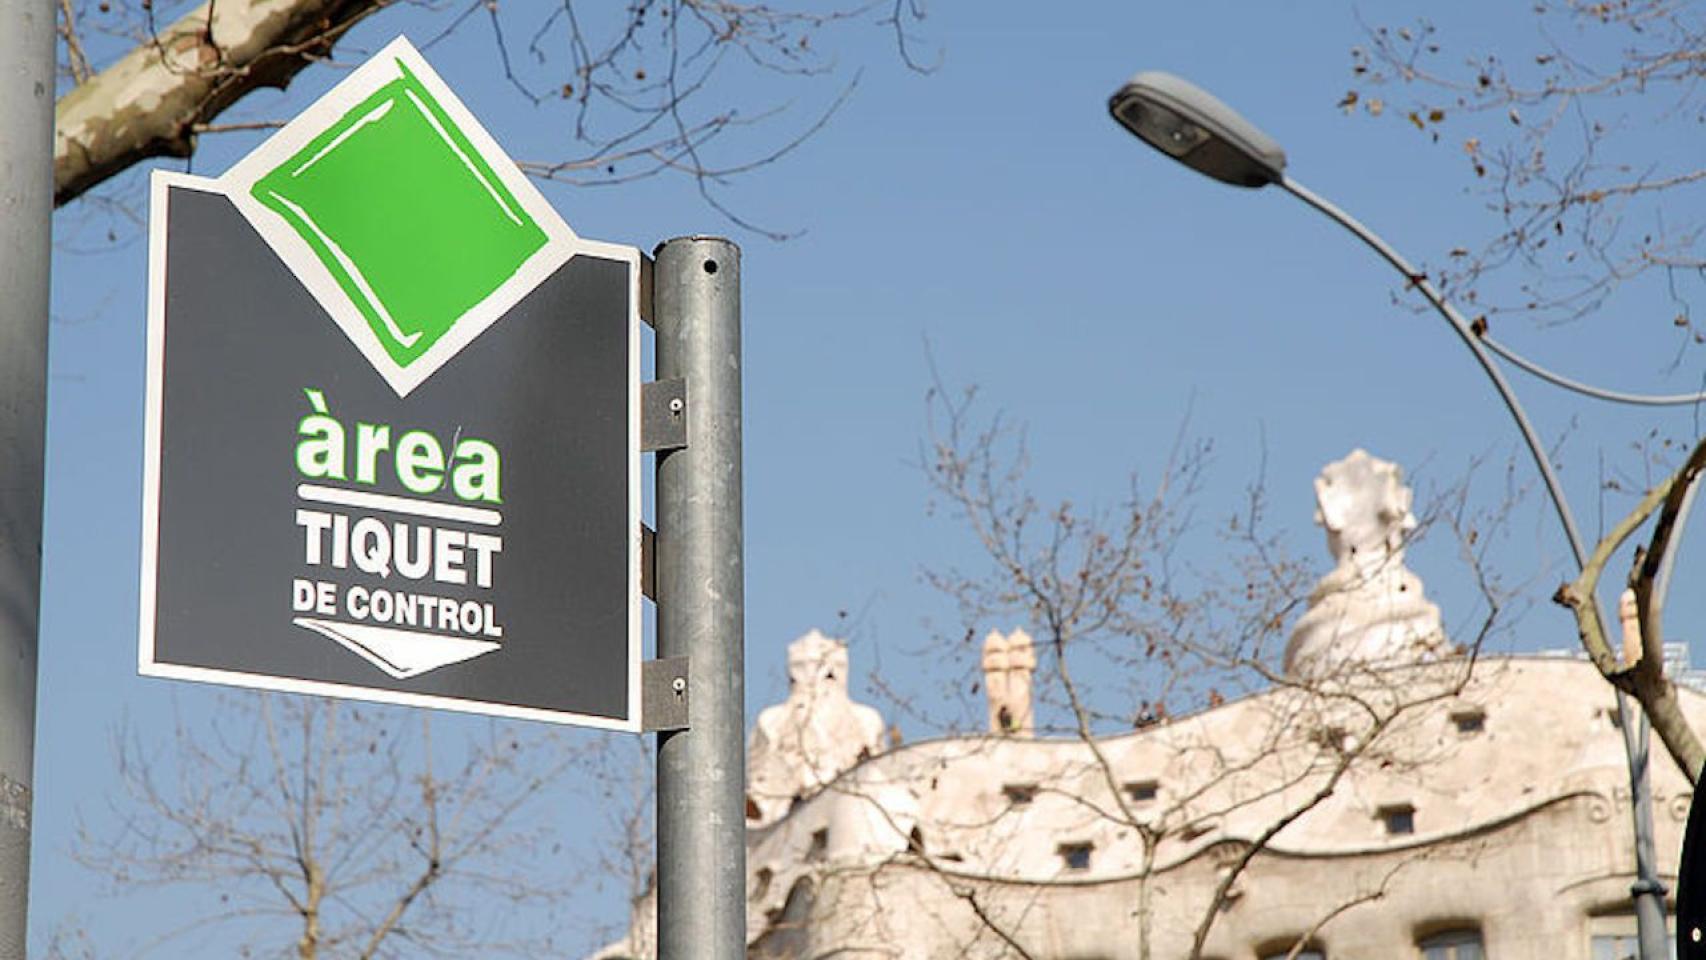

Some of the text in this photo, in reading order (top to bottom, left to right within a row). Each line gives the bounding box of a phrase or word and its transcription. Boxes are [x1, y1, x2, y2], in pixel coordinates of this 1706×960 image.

[296, 387, 502, 504] àrea
[295, 508, 502, 588] TIQUET
[292, 578, 503, 637] DE CONTROL
